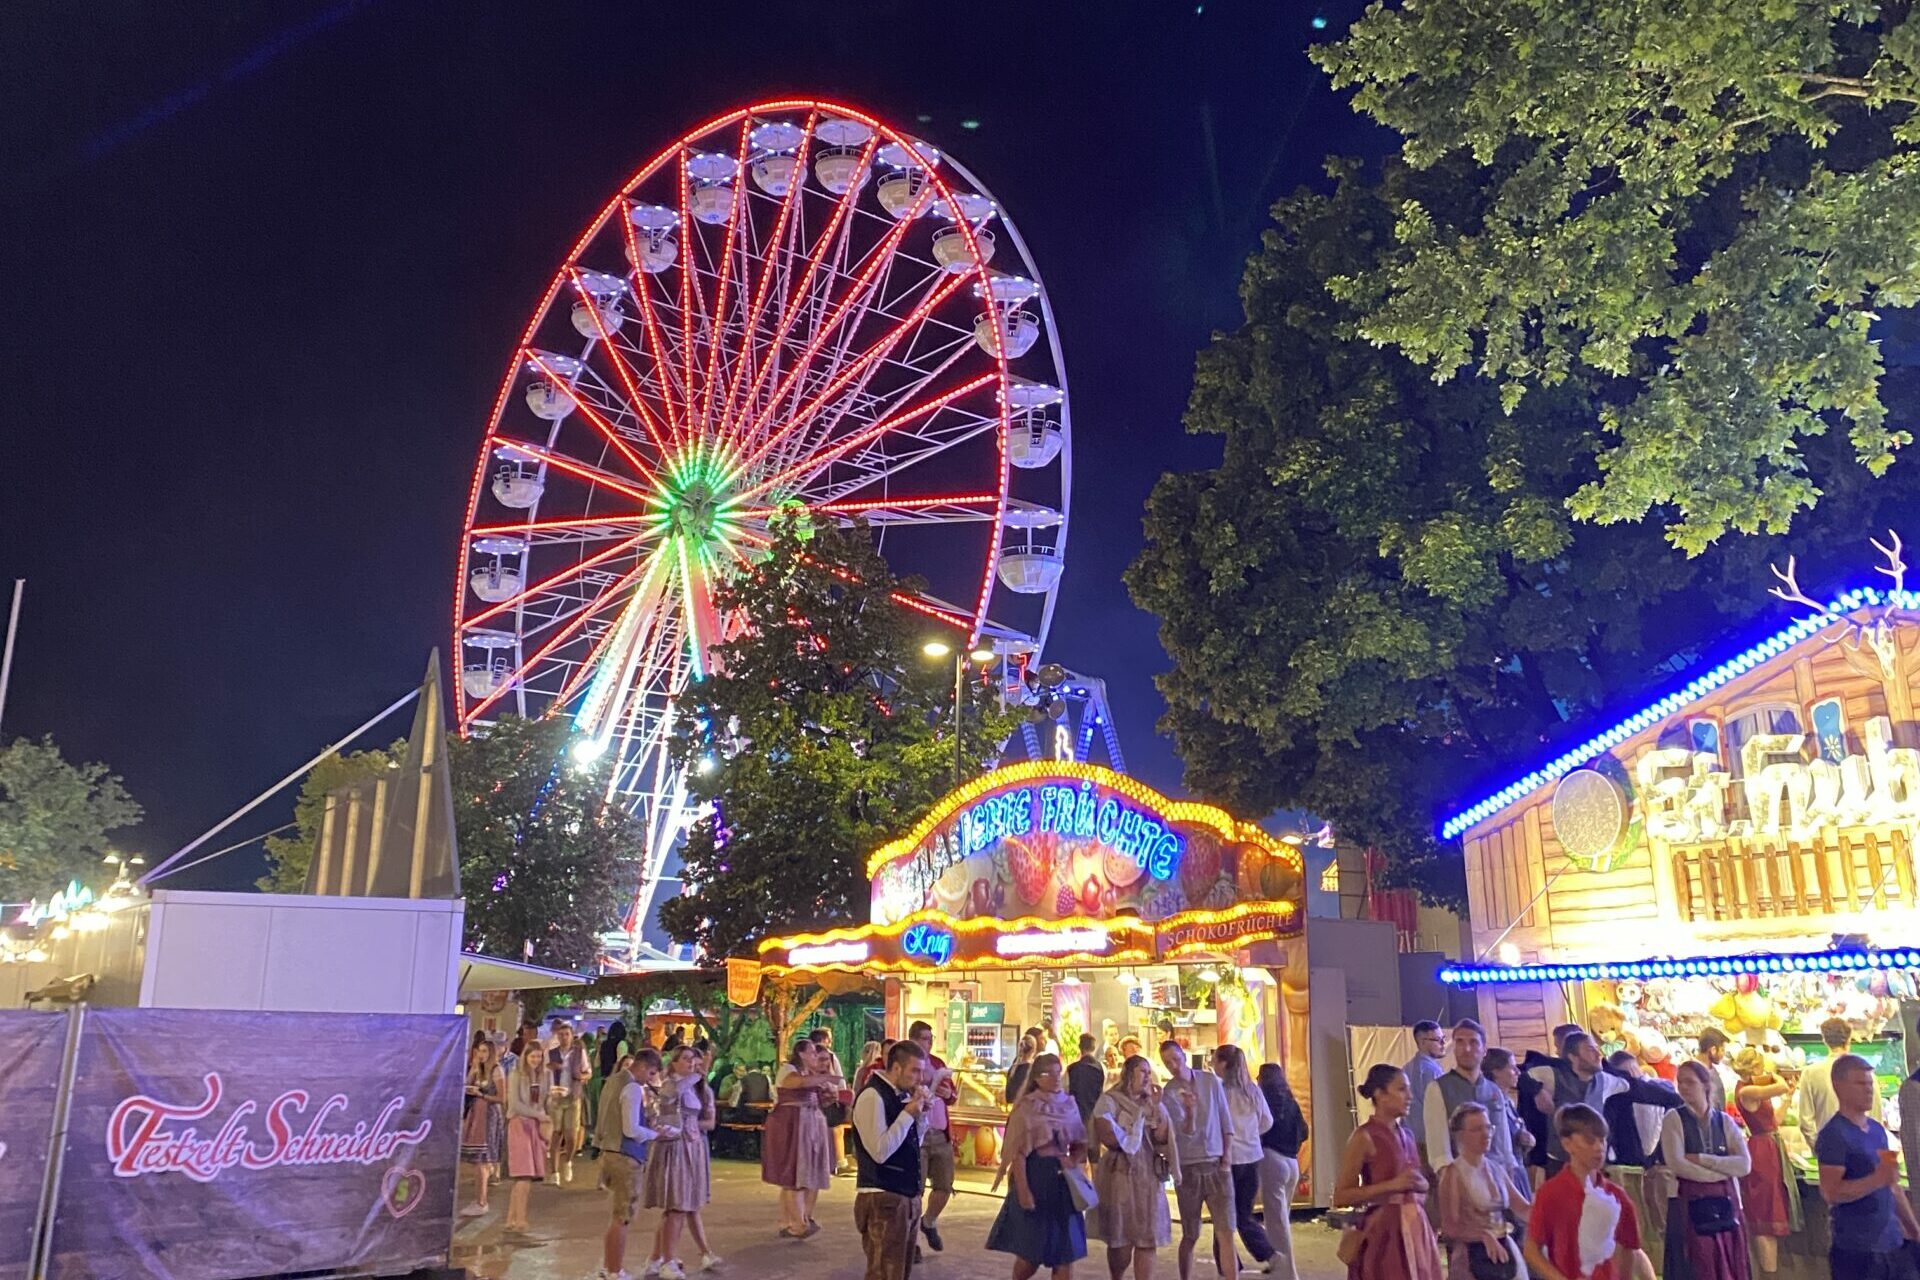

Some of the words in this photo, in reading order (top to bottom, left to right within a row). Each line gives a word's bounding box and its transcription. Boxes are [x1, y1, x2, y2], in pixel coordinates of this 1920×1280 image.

[1040, 780, 1179, 880] FRÜCHTE
[903, 925, 951, 966] Krug
[1167, 912, 1293, 947] SCHOKOFRÜCHTE
[106, 1071, 257, 1183] Festzelt
[240, 1089, 432, 1170] Schneider
